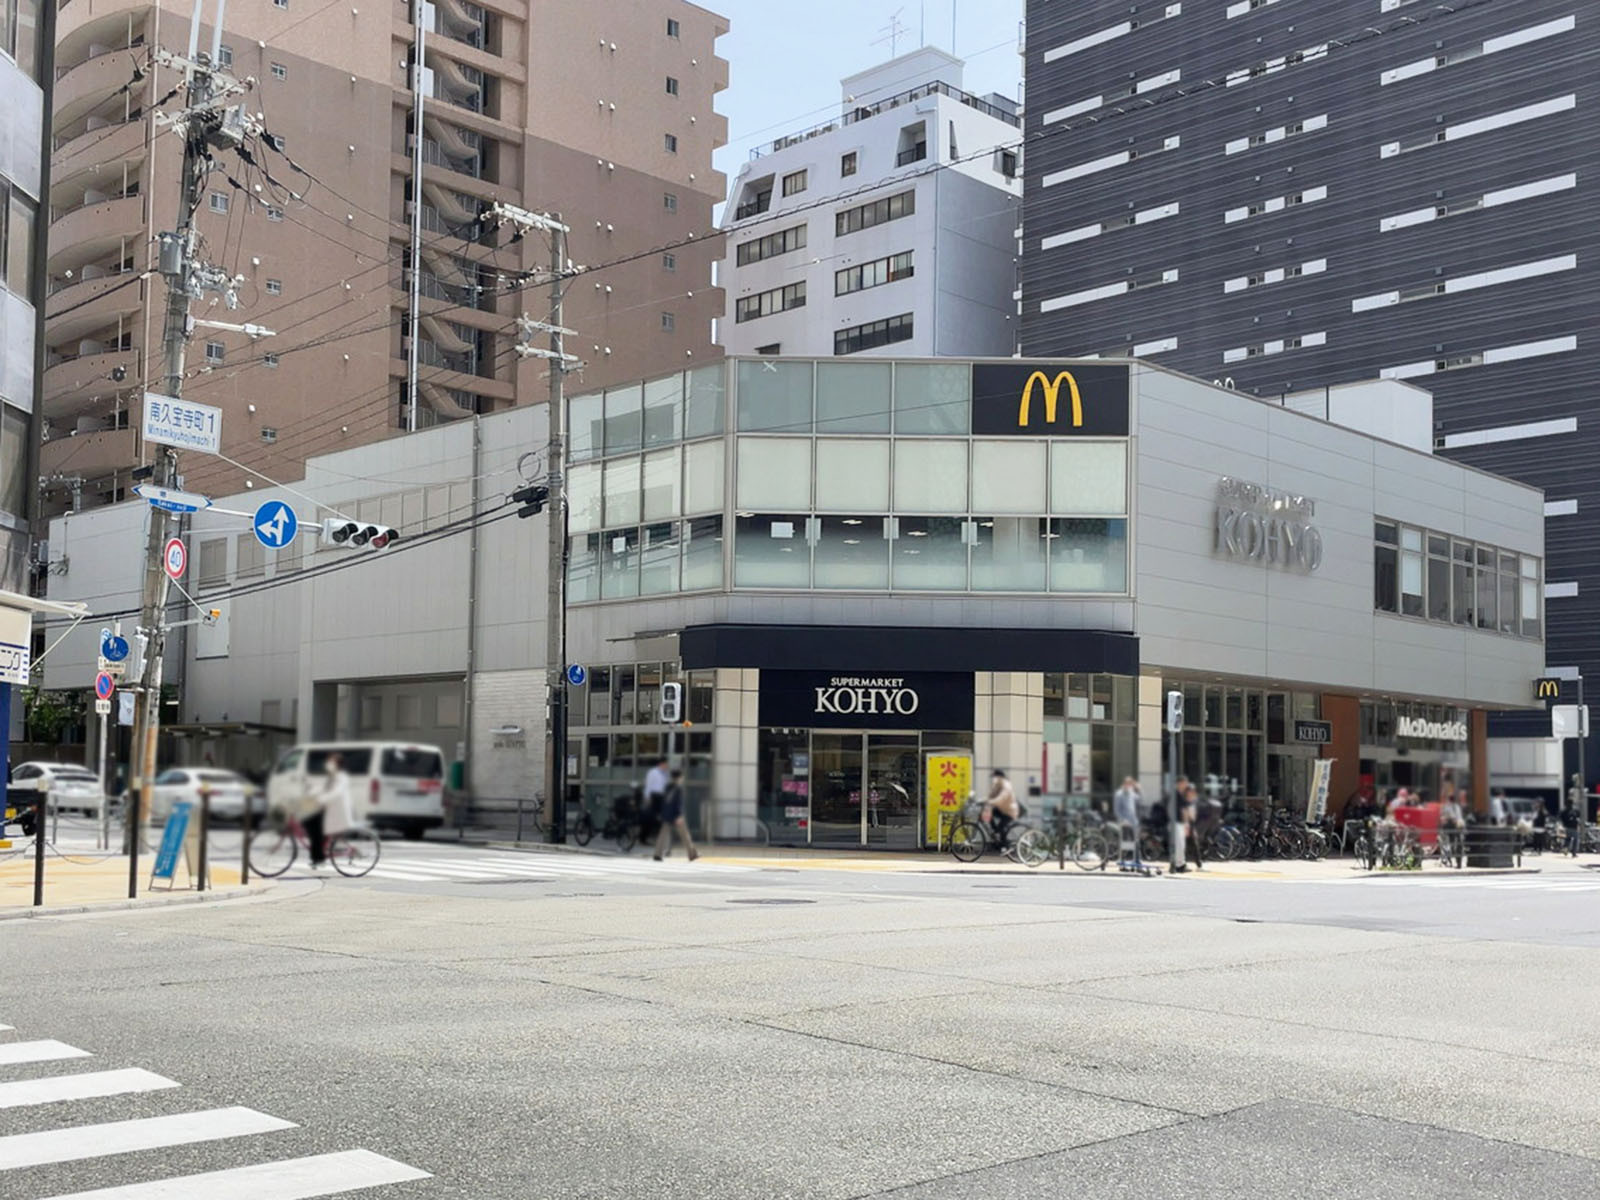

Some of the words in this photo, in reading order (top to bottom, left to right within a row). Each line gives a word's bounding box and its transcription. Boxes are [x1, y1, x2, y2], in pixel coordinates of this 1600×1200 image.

[1213, 505, 1323, 572] KOHYO
[169, 550, 181, 568] 40
[830, 677, 904, 688] SUPERMARKET
[814, 687, 919, 715] KOHYO
[1299, 726, 1327, 741] KOHYO
[1398, 716, 1467, 741] McDonald's
